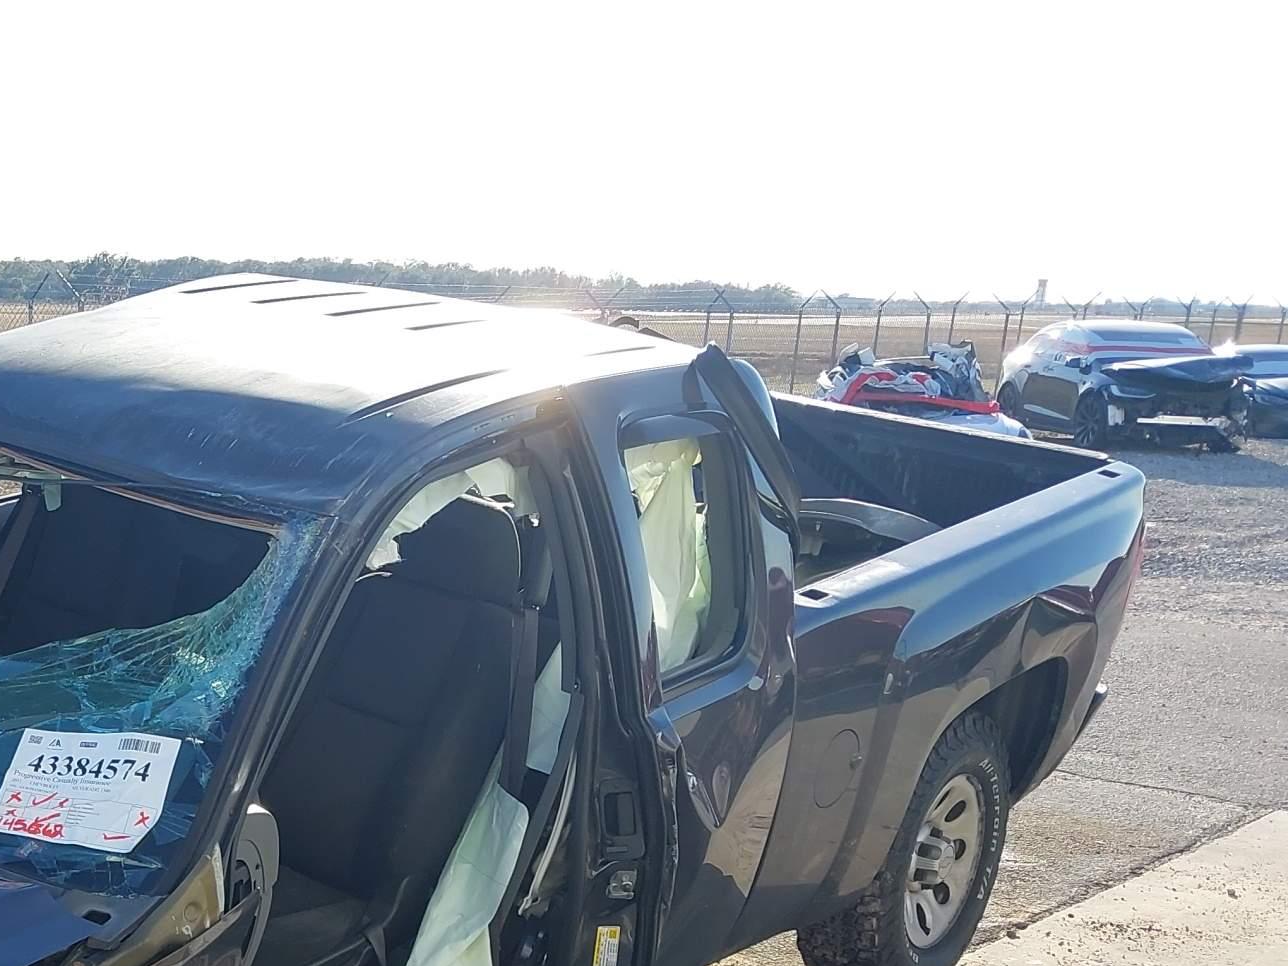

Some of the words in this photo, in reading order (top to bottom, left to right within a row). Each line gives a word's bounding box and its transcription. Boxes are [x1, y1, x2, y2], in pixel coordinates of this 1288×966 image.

[14, 769, 51, 782] Progressive
[52, 776, 78, 785] Casualty
[27, 754, 151, 782] 43384574
[976, 864, 993, 900] T/A
